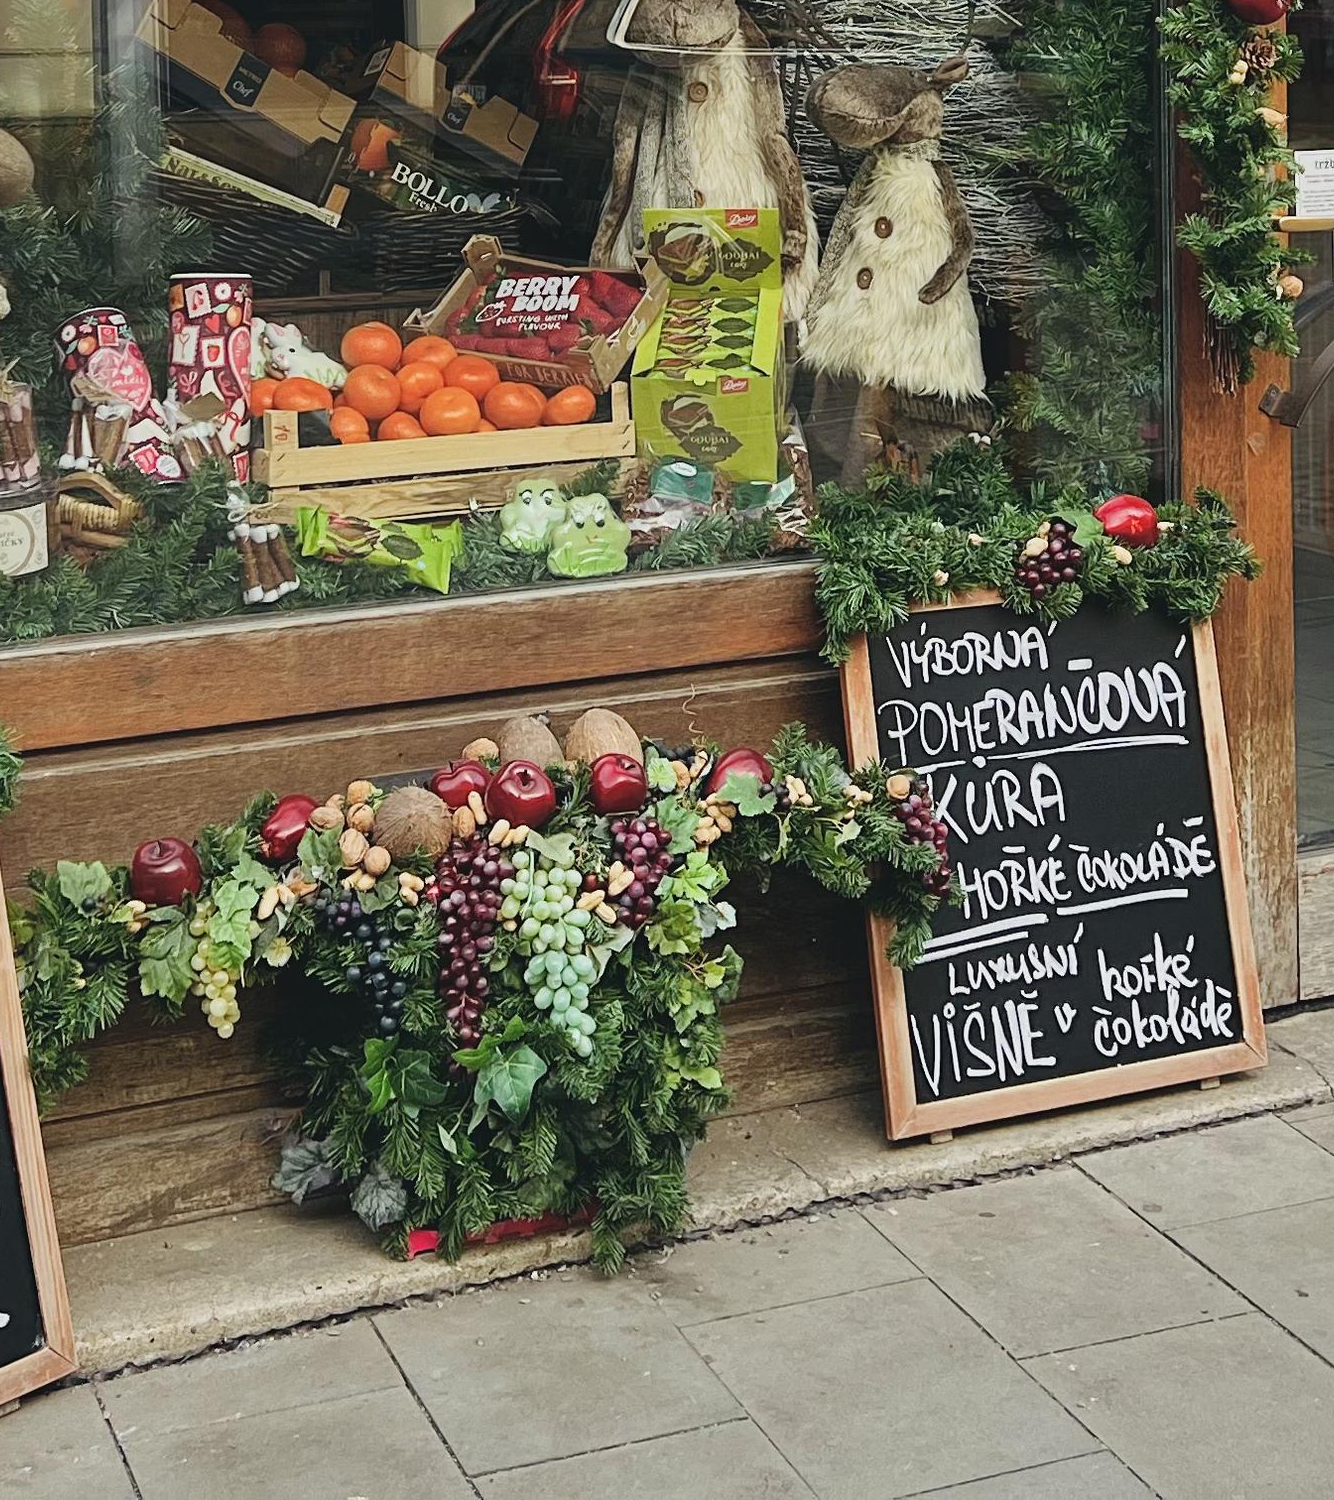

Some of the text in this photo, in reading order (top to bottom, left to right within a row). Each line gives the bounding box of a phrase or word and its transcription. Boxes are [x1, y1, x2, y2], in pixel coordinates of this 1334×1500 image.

[391, 162, 468, 214] BOLLO
[408, 191, 438, 212] Fresh
[495, 275, 581, 298] BERRY
[511, 294, 580, 312] BOOM
[518, 322, 562, 332] FLAVOUR
[886, 622, 1057, 688] VÝBORNÁ
